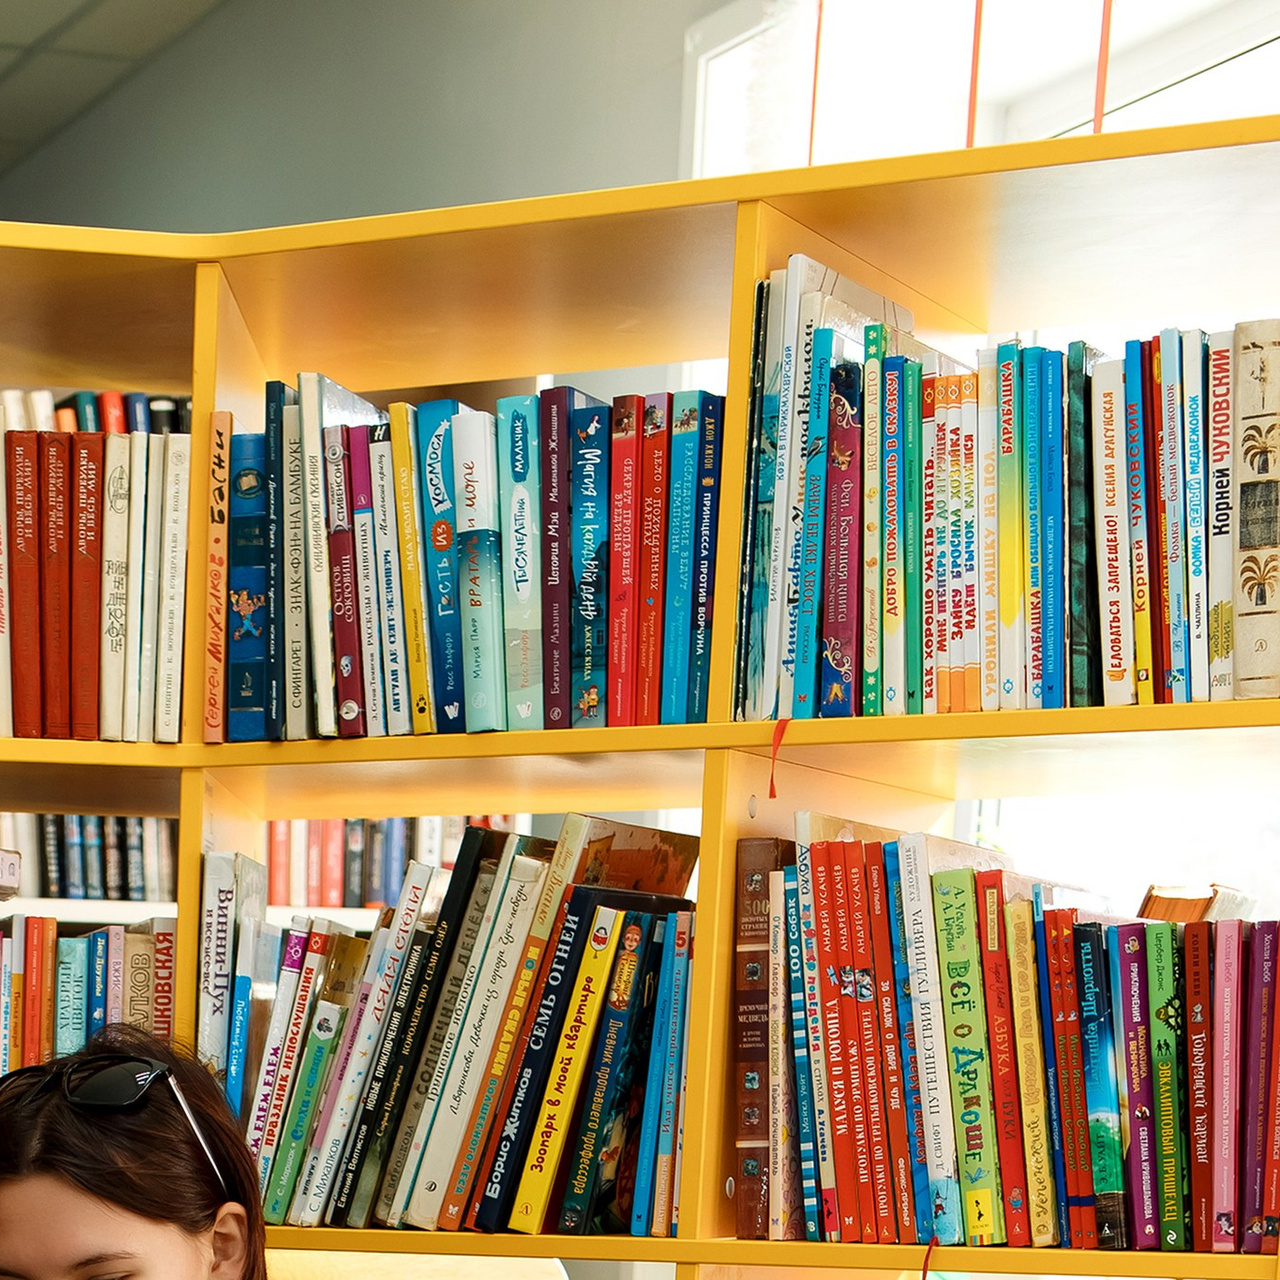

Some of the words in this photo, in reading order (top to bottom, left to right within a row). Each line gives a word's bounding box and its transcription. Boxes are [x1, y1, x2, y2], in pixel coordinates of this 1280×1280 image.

[886, 371, 899, 434] СКАЗКУ!
[1001, 361, 1013, 455] БАРАБАШКА
[1103, 391, 1115, 459] ДРАГУНСКАЯ
[1211, 349, 1230, 463] ЧУКОВСКИЙ
[289, 437, 301, 504] БАМБУКЕ
[514, 419, 525, 473] МАЛЬЧИК
[887, 440, 897, 449] В
[1127, 403, 1142, 527] ЧУКОВСКИЙ
[334, 463, 346, 522] СТИВЕНСОН
[549, 453, 558, 502] Маленькой
[885, 454, 898, 562] ПОЖАЛОВАТЬ
[1103, 464, 1116, 507] КСЕНИЯ
[1212, 468, 1233, 536] Корней
[290, 510, 301, 529] НА
[548, 512, 559, 537] Мэй
[702, 493, 711, 560] ПРИНЦЕССА
[548, 542, 559, 585] История
[699, 564, 708, 603] ПРОТИВ
[1106, 514, 1120, 592] ЗАПРЕЩЕНО!
[1133, 540, 1147, 613] Корней
[290, 576, 302, 613] ЗНАК
[342, 555, 354, 622] СОКРОВИЩ
[885, 567, 898, 616] ДОБРО
[696, 607, 707, 655] ВОРЧУНА
[1106, 600, 1125, 682] ЦЕЛОВАТЬСЯ
[817, 866, 827, 904] УСАЧЕВ
[786, 897, 798, 939] Собак
[822, 906, 832, 952] АНДРЕЙ
[530, 994, 556, 1050] СЕМЬ
[548, 913, 579, 986] ОГНЕЙ
[789, 946, 801, 980] 100
[912, 909, 930, 994] ГУЛЛИВЕРА
[947, 961, 971, 1011] ВСЁ
[264, 1074, 289, 1147] ПРАЗДНИК
[283, 966, 314, 1070] НЕПОСЛУШАНИЯ
[365, 1081, 382, 1110] НОВЫЕ
[375, 1012, 402, 1078] ПРИКЛЮЧЕНИЯ
[394, 944, 422, 1008] ЭЛЕКТРОНИКА
[825, 999, 842, 1062] РОГОПЕД
[919, 1001, 940, 1115] ПУТЕШЕСТВИЯ
[530, 1113, 559, 1173] Зоопарк
[553, 1056, 573, 1093] моей
[564, 976, 595, 1050] квартире
[953, 1046, 984, 1163] ДРАКОШЕ
[484, 1141, 511, 1199] Борис
[501, 1067, 533, 1141] Житков
[832, 1079, 849, 1135] МАЛУСЯ
[1158, 1061, 1174, 1156] ЭВКАЛИПТОВЫЙ
[314, 1138, 341, 1197] Михалков
[1161, 1159, 1178, 1220] ПРИШЕЛЕЦ
